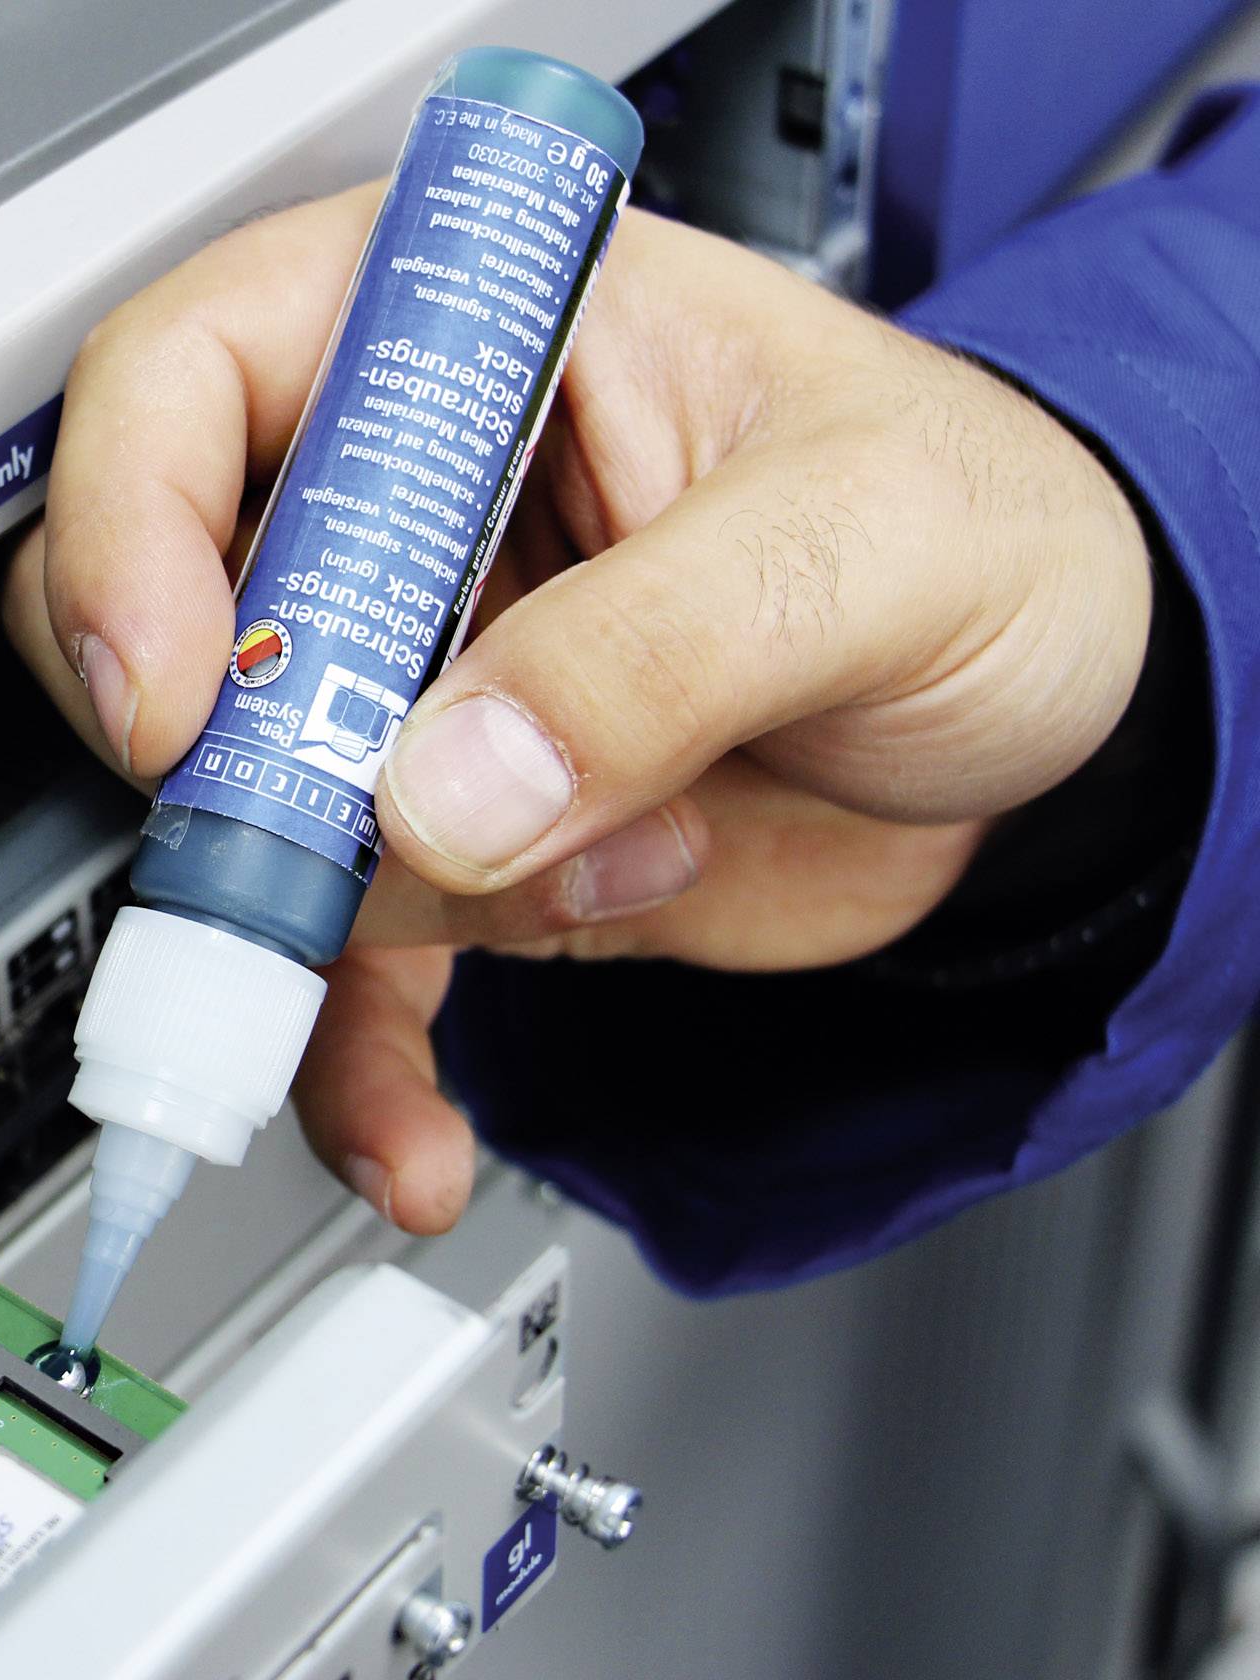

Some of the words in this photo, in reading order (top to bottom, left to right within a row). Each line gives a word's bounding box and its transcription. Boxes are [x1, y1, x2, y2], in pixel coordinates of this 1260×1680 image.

[459, 112, 481, 129] the
[484, 119, 498, 134] in
[501, 119, 542, 149] Made
[467, 143, 550, 184] 30022030
[569, 146, 588, 171] g
[585, 163, 609, 195] 30
[425, 186, 482, 208] nahezu
[452, 165, 546, 208] Materialien
[482, 198, 513, 219] auf
[547, 205, 581, 229] allen
[429, 212, 563, 275] schnelltrocknend
[514, 207, 572, 255] Haftung
[391, 257, 470, 285] versiegeln
[479, 253, 554, 298] siliconfrei
[413, 285, 491, 322] signieren,
[476, 276, 556, 330] plombieren,
[496, 313, 546, 354] sichern,
[367, 338, 523, 415] sicherungs-
[474, 341, 534, 394] Lack
[359, 366, 513, 446] Schrauben-
[364, 396, 458, 440] Materialien
[337, 416, 392, 439] nahezu
[393, 430, 424, 451] auf
[460, 432, 493, 457] allen
[340, 443, 475, 505] schnelltrocknend
[426, 437, 485, 486] Haftung
[301, 487, 381, 517] versiegeln
[390, 484, 466, 530] siliconfrei
[324, 514, 403, 554] signieren,
[387, 506, 469, 561] plombieren,
[472, 542, 487, 570] grün
[486, 480, 509, 528] Colour:
[320, 548, 379, 584] (grün)
[407, 545, 458, 585] sichern,
[276, 571, 435, 647] sicherungs-
[383, 574, 446, 627] Lack
[269, 600, 424, 680] Schrauben-
[234, 692, 303, 730] System
[251, 719, 296, 750] Pen-
[508, 1523, 532, 1573] gl
[495, 1553, 543, 1606] module
